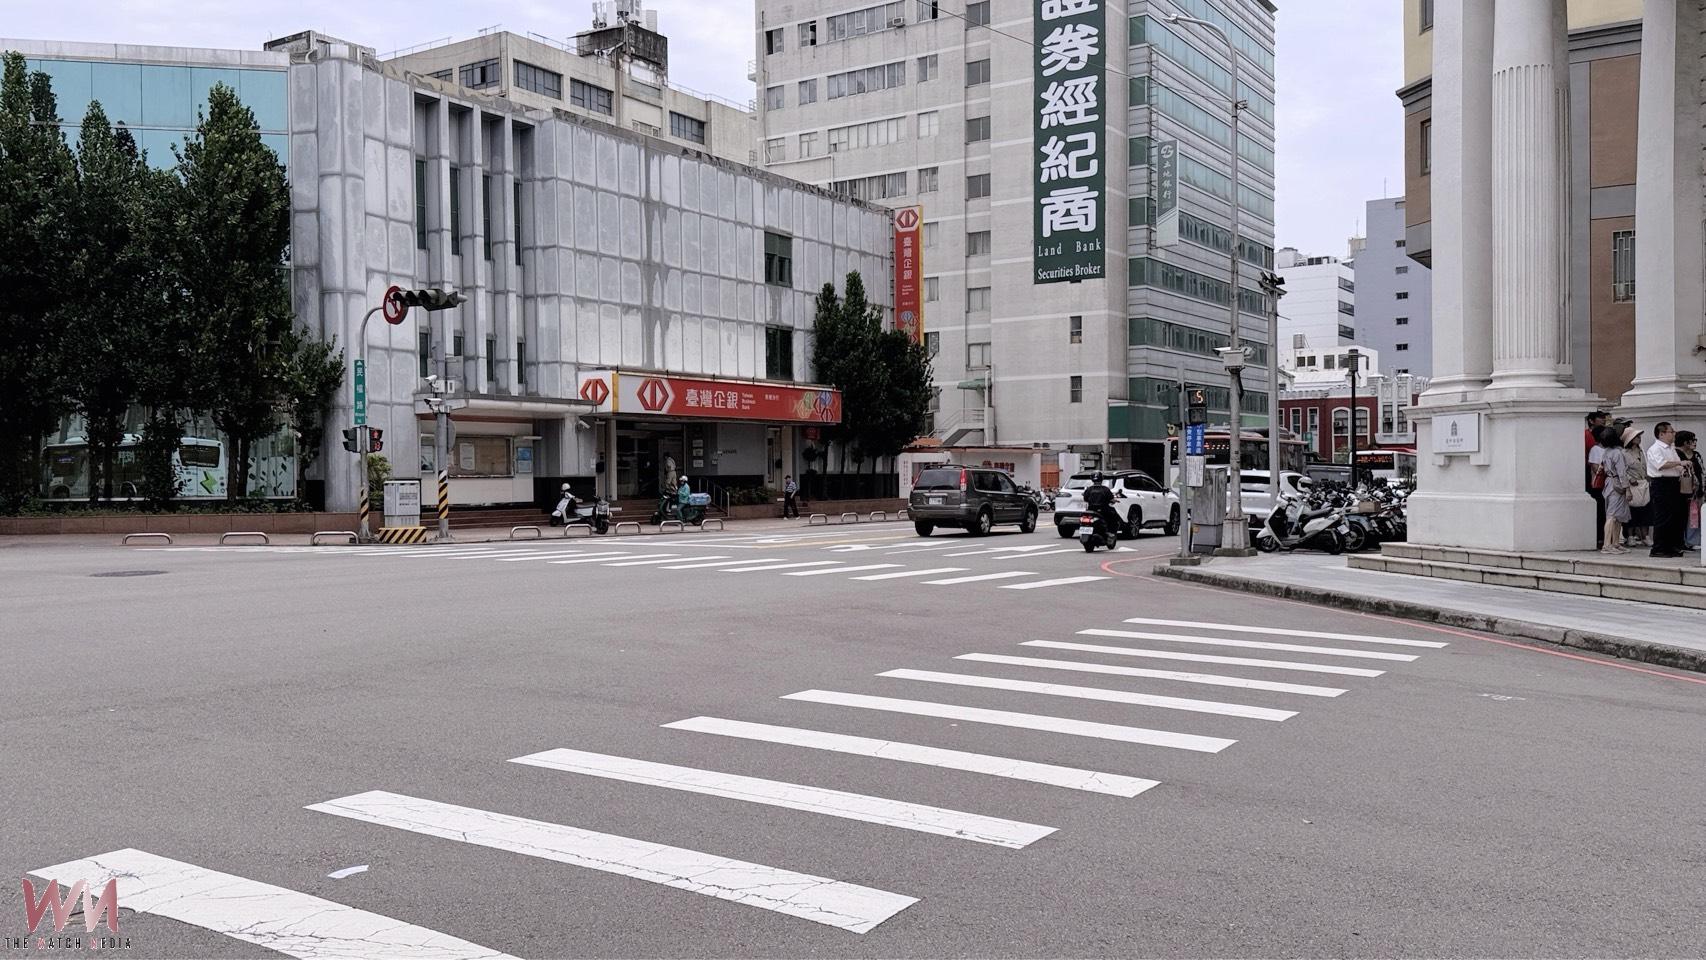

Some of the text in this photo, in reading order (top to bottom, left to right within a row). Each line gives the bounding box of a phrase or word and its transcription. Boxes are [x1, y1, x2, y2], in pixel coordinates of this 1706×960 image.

[1038, 238, 1102, 257] Land Bank
[1037, 262, 1101, 280] Securities Broker
[686, 388, 738, 409] 臺灣企銀
